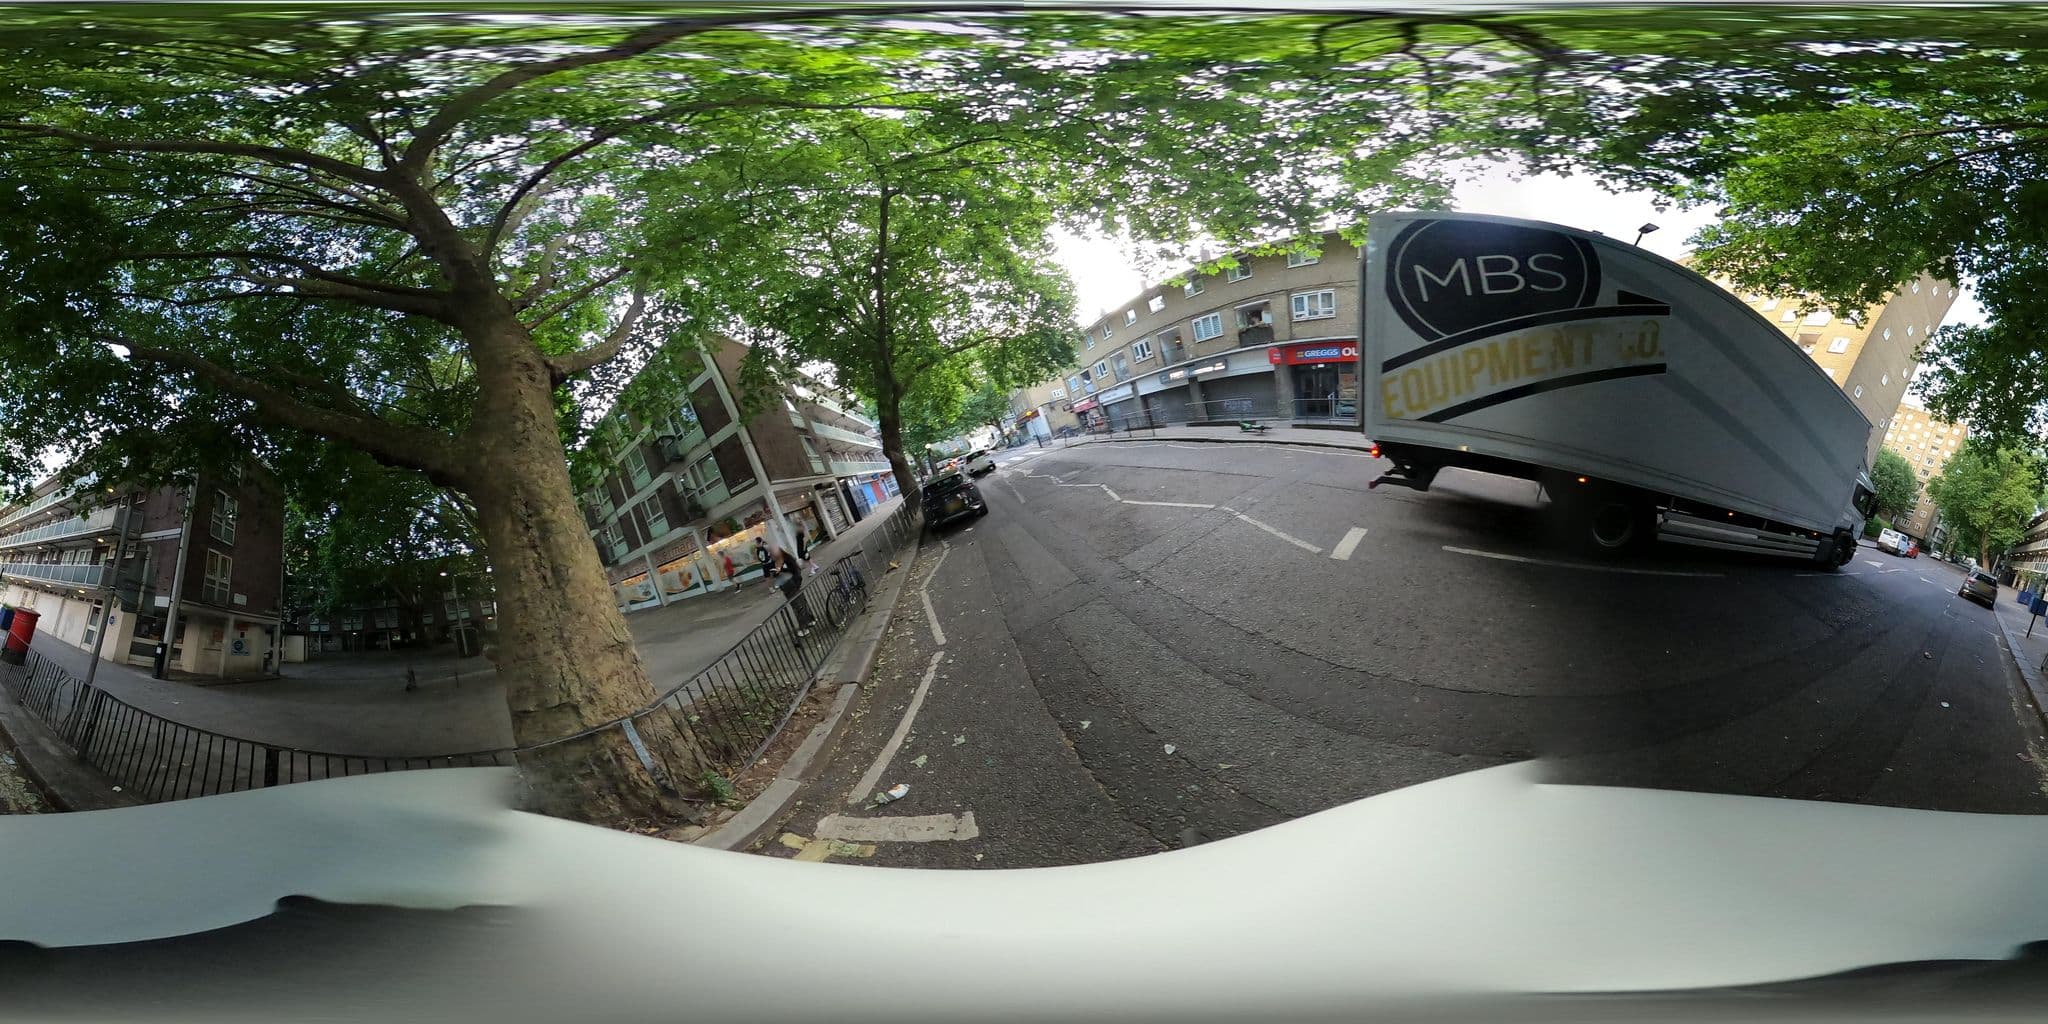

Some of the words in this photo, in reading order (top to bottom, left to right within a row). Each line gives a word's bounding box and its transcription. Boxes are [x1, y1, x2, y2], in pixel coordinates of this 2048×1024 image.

[1413, 253, 1567, 302] MBS
[1304, 348, 1339, 357] GREGGS
[1381, 327, 1594, 418] EQUIPMENT
